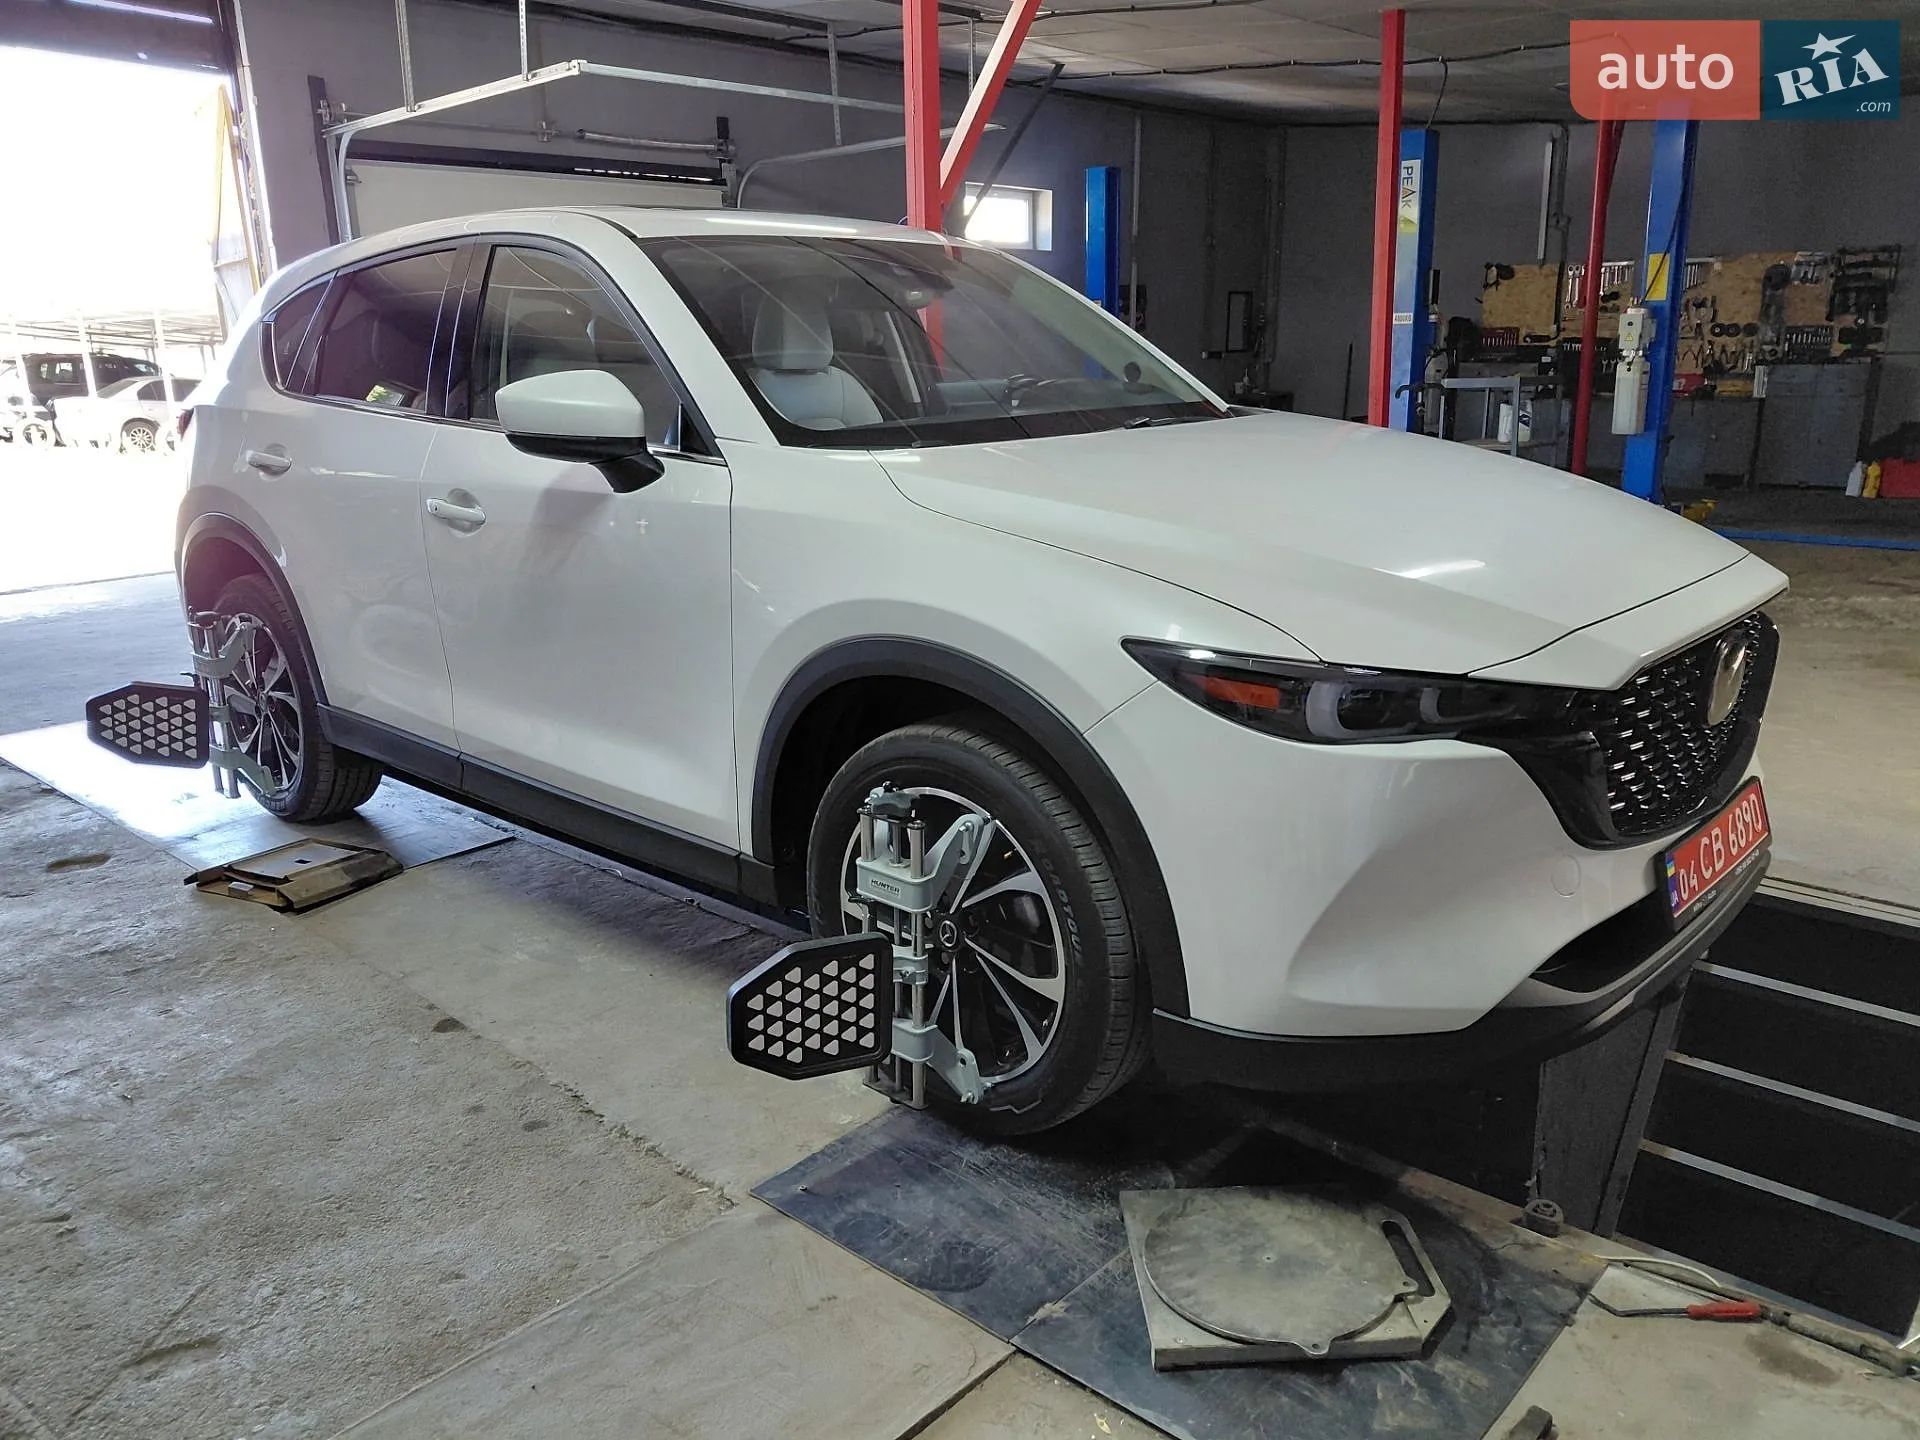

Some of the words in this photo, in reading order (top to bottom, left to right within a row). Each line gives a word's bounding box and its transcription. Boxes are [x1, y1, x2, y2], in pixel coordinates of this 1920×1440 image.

[1402, 166, 1416, 209] PEAK
[1678, 860, 1699, 901] 04
[1700, 826, 1725, 880] CB
[1728, 792, 1763, 856] 6890
[871, 878, 900, 895] HUNTER
